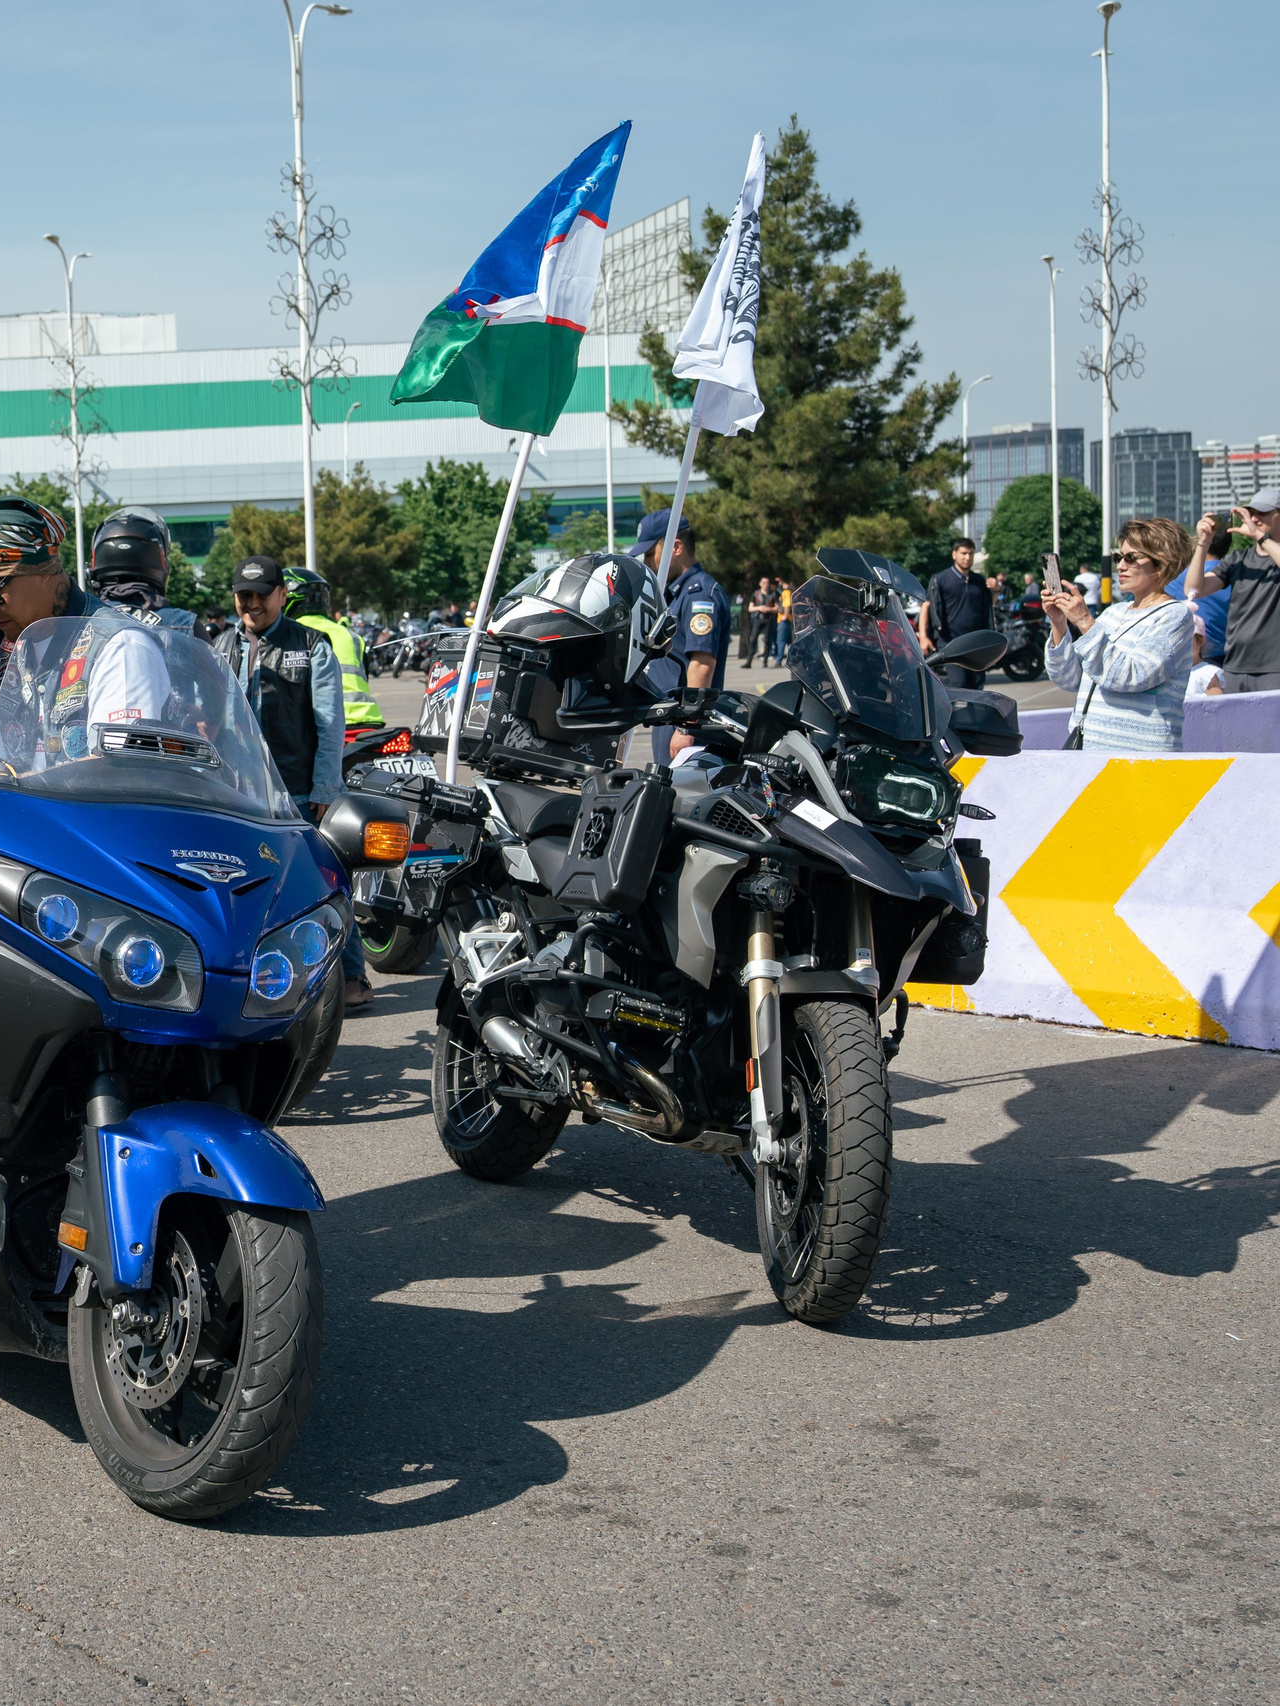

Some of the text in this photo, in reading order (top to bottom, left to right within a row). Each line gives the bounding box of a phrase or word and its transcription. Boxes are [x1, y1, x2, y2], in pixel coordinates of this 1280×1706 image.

[477, 671, 494, 679] GS
[110, 709, 141, 722] MOTUL
[171, 849, 246, 866] HONDA
[409, 858, 443, 874] GS
[72, 1364, 107, 1456] MARATHON
[107, 1452, 141, 1486] ULTRA
